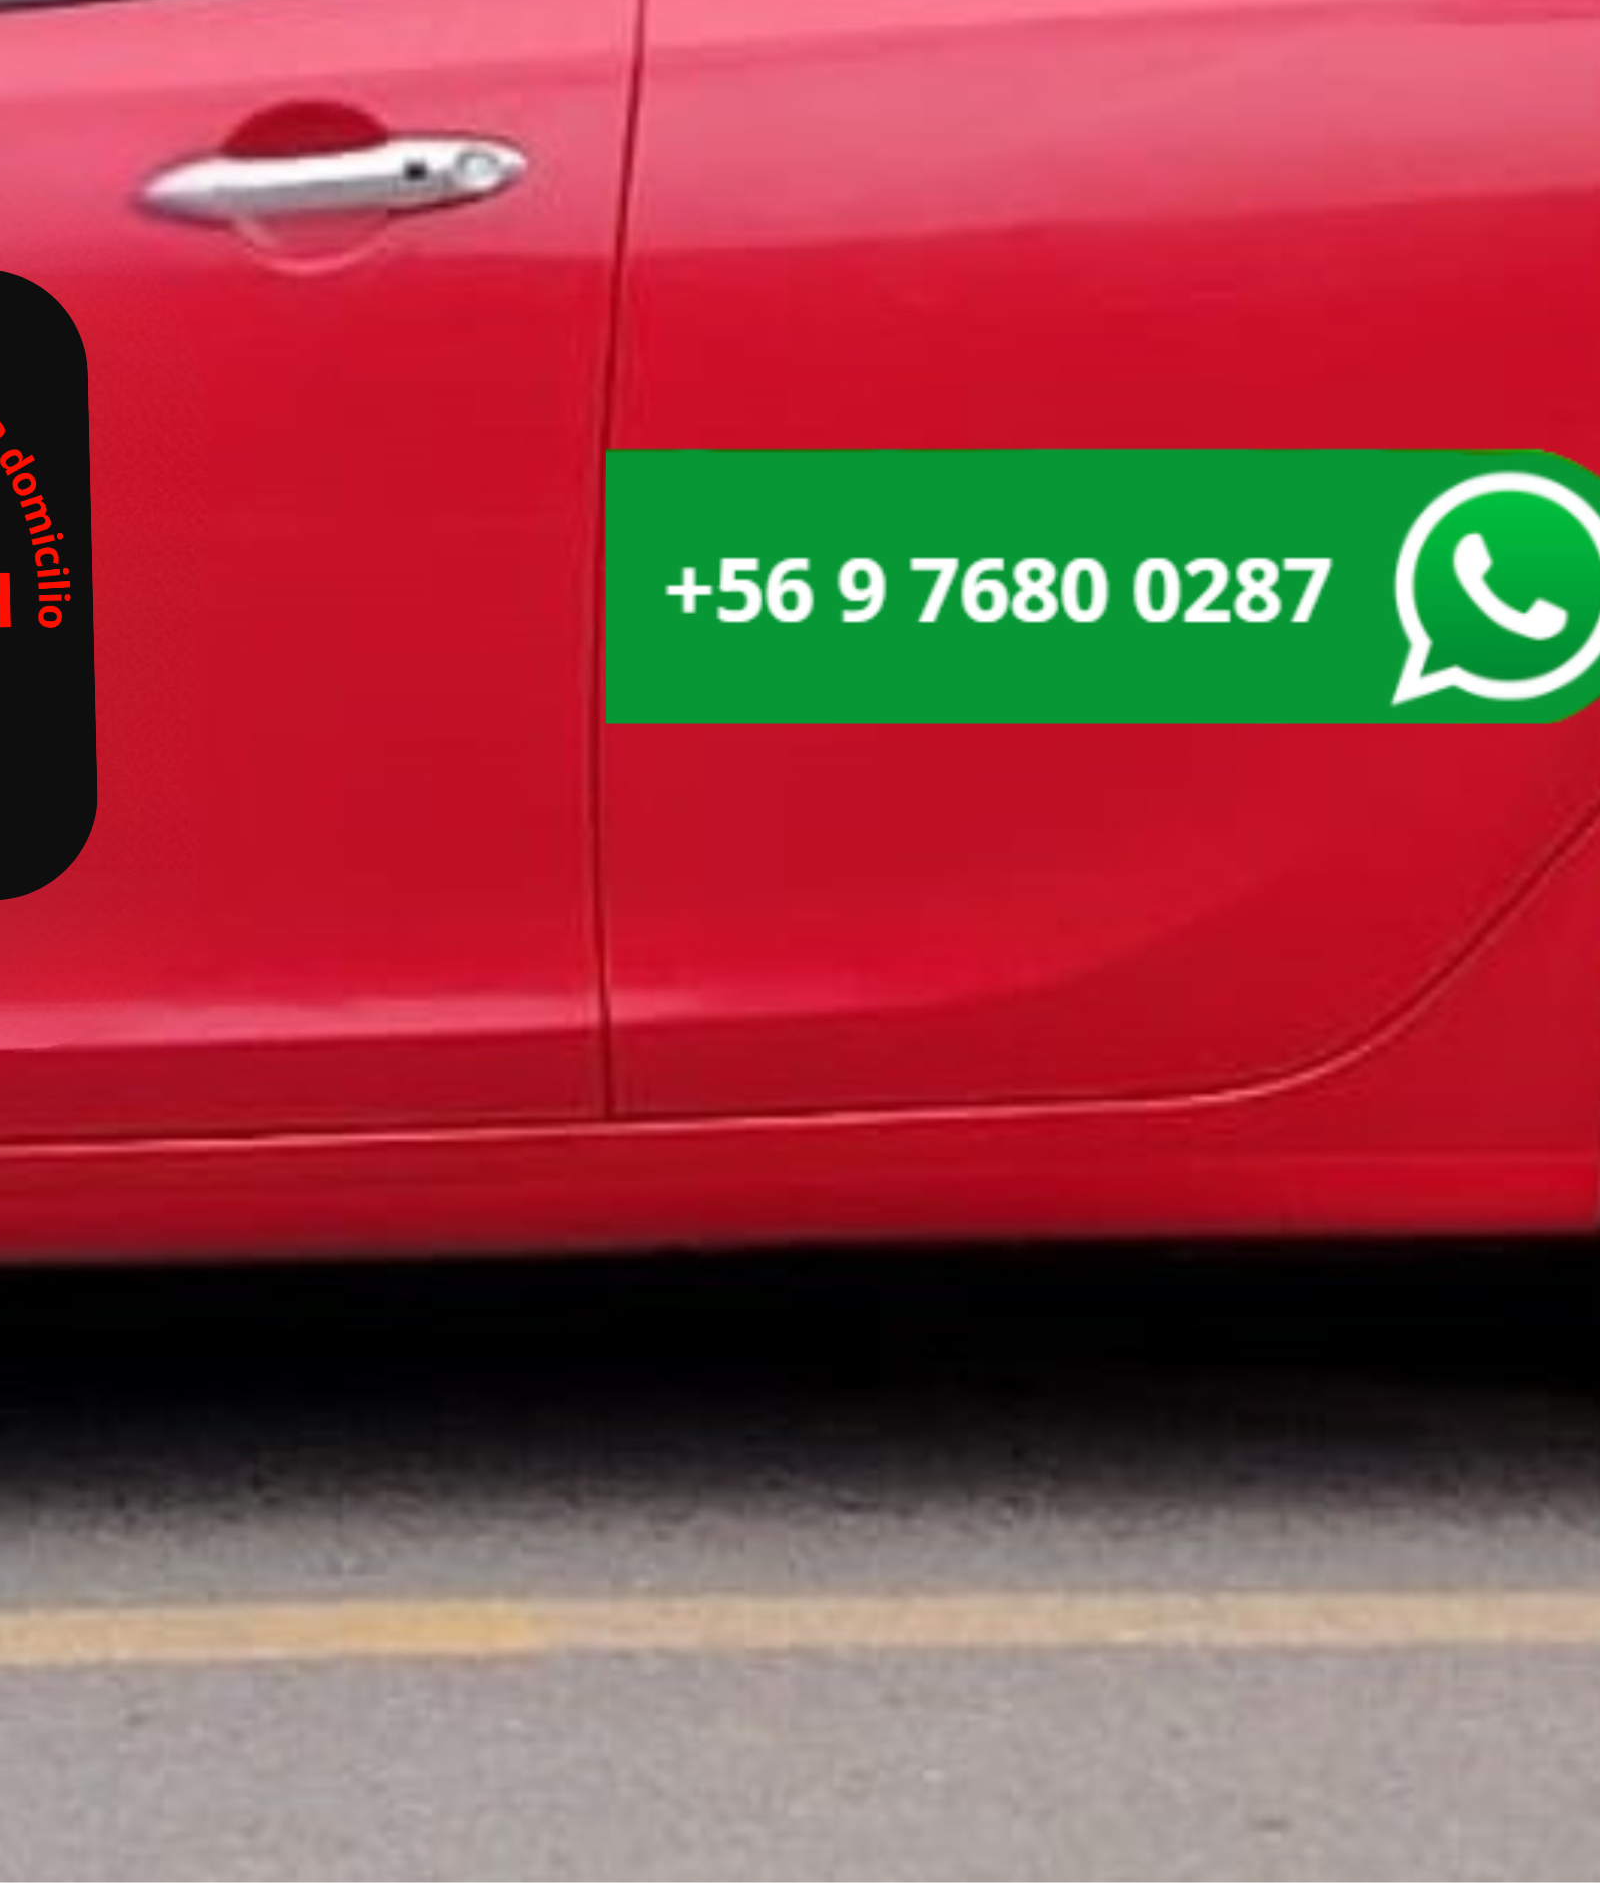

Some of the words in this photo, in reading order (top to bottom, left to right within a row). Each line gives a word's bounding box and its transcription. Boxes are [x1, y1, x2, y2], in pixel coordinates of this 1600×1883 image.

[0, 448, 72, 629] domicilio
[666, 557, 814, 623] +56
[838, 557, 886, 623] 9
[910, 557, 1109, 623] 7680
[1133, 557, 1332, 623] 0287
